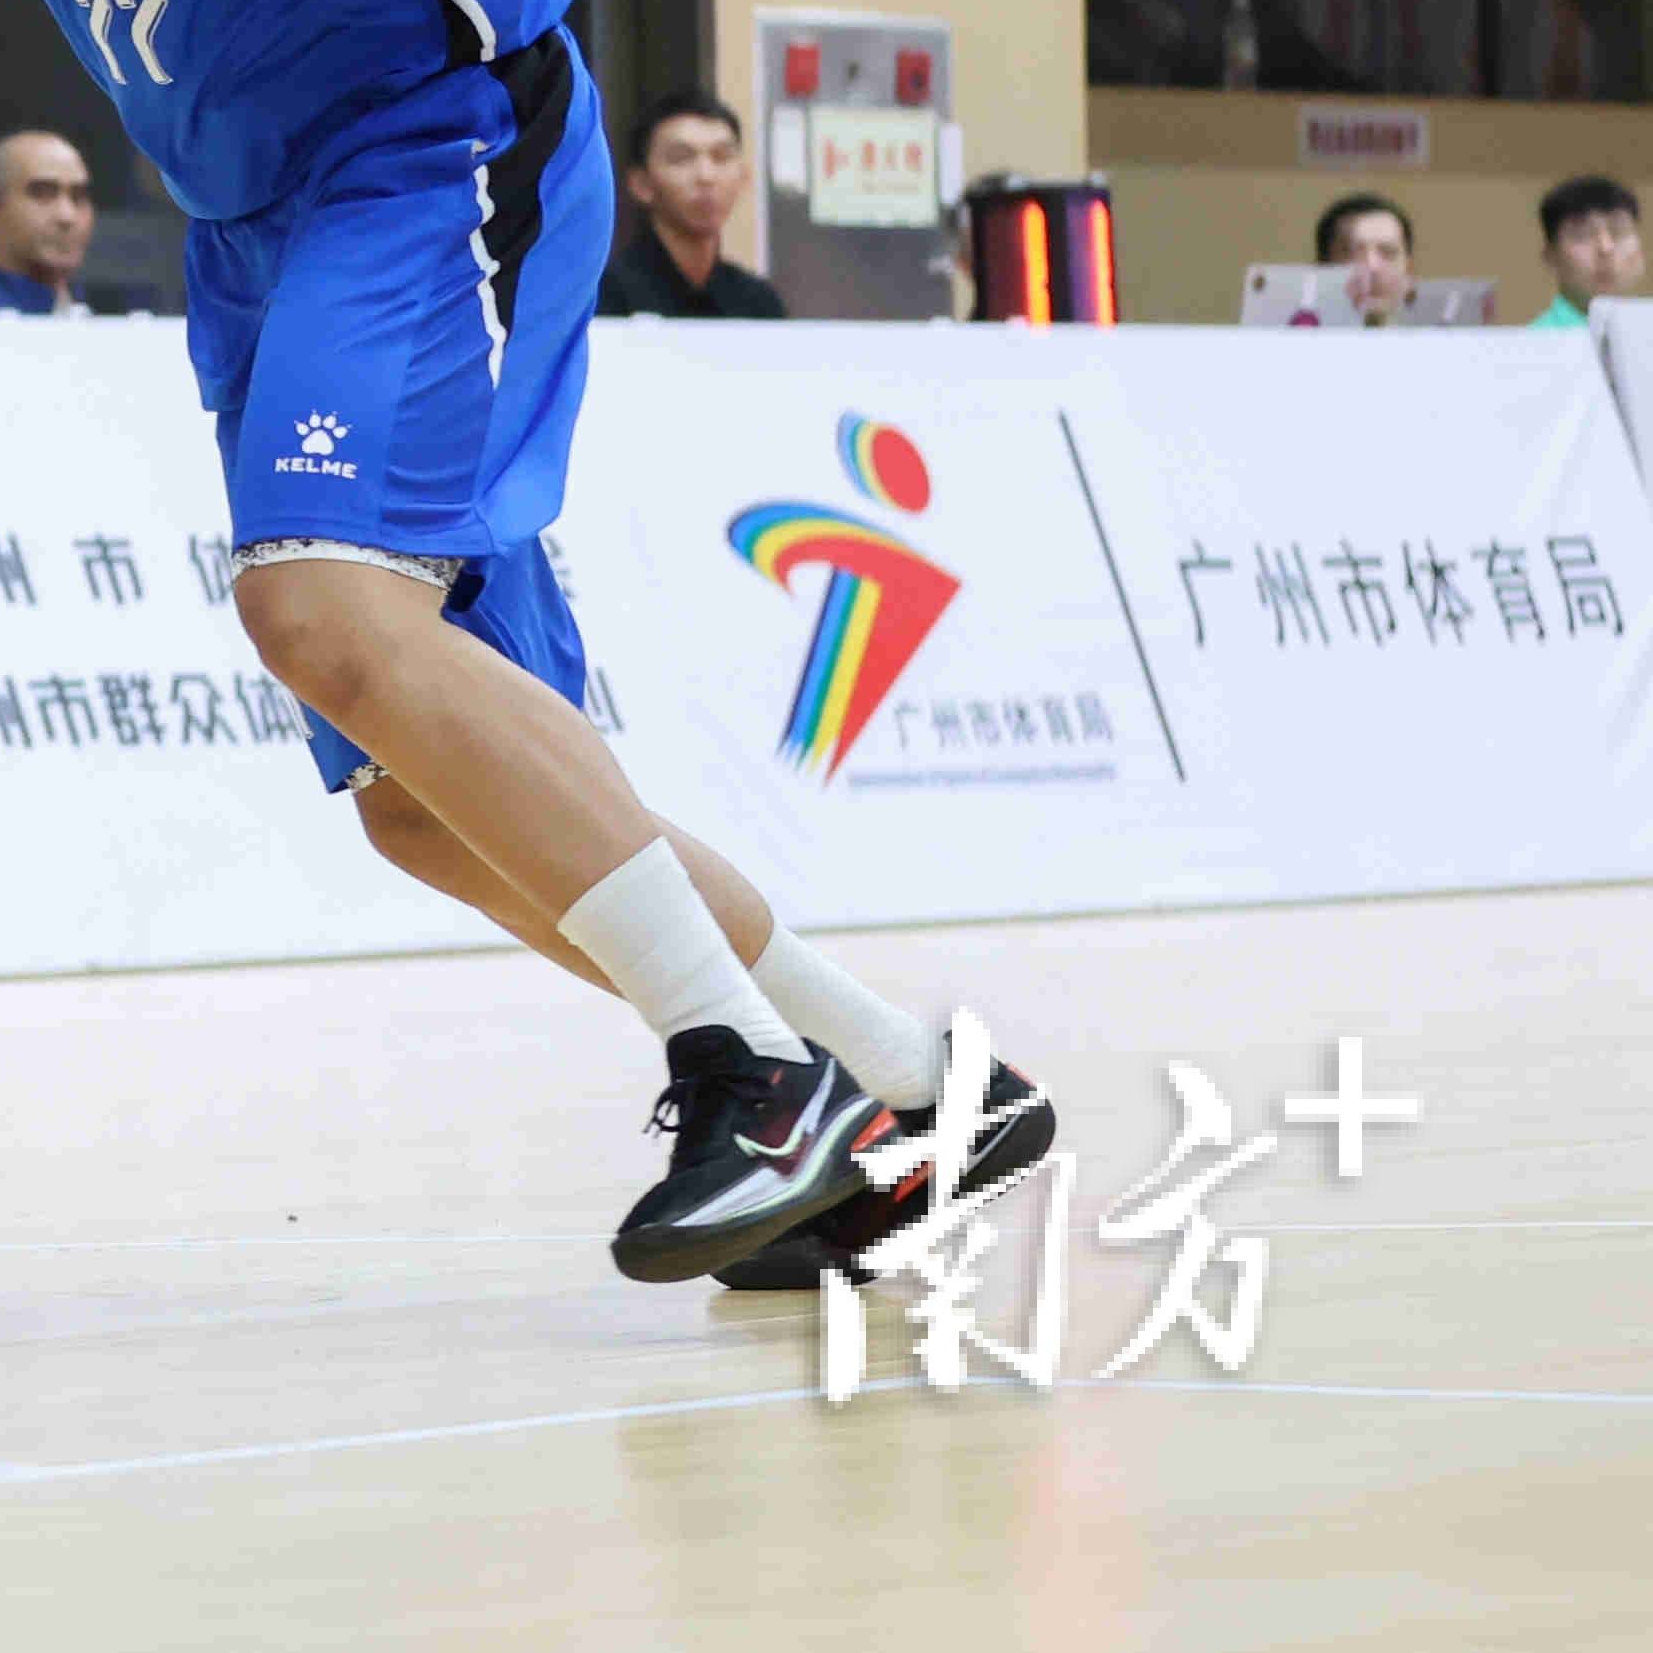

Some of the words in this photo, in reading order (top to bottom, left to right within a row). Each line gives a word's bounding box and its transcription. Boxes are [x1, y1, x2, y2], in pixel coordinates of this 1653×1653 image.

[274, 456, 358, 480] KELME
[1178, 534, 1625, 649] 广州市体育局
